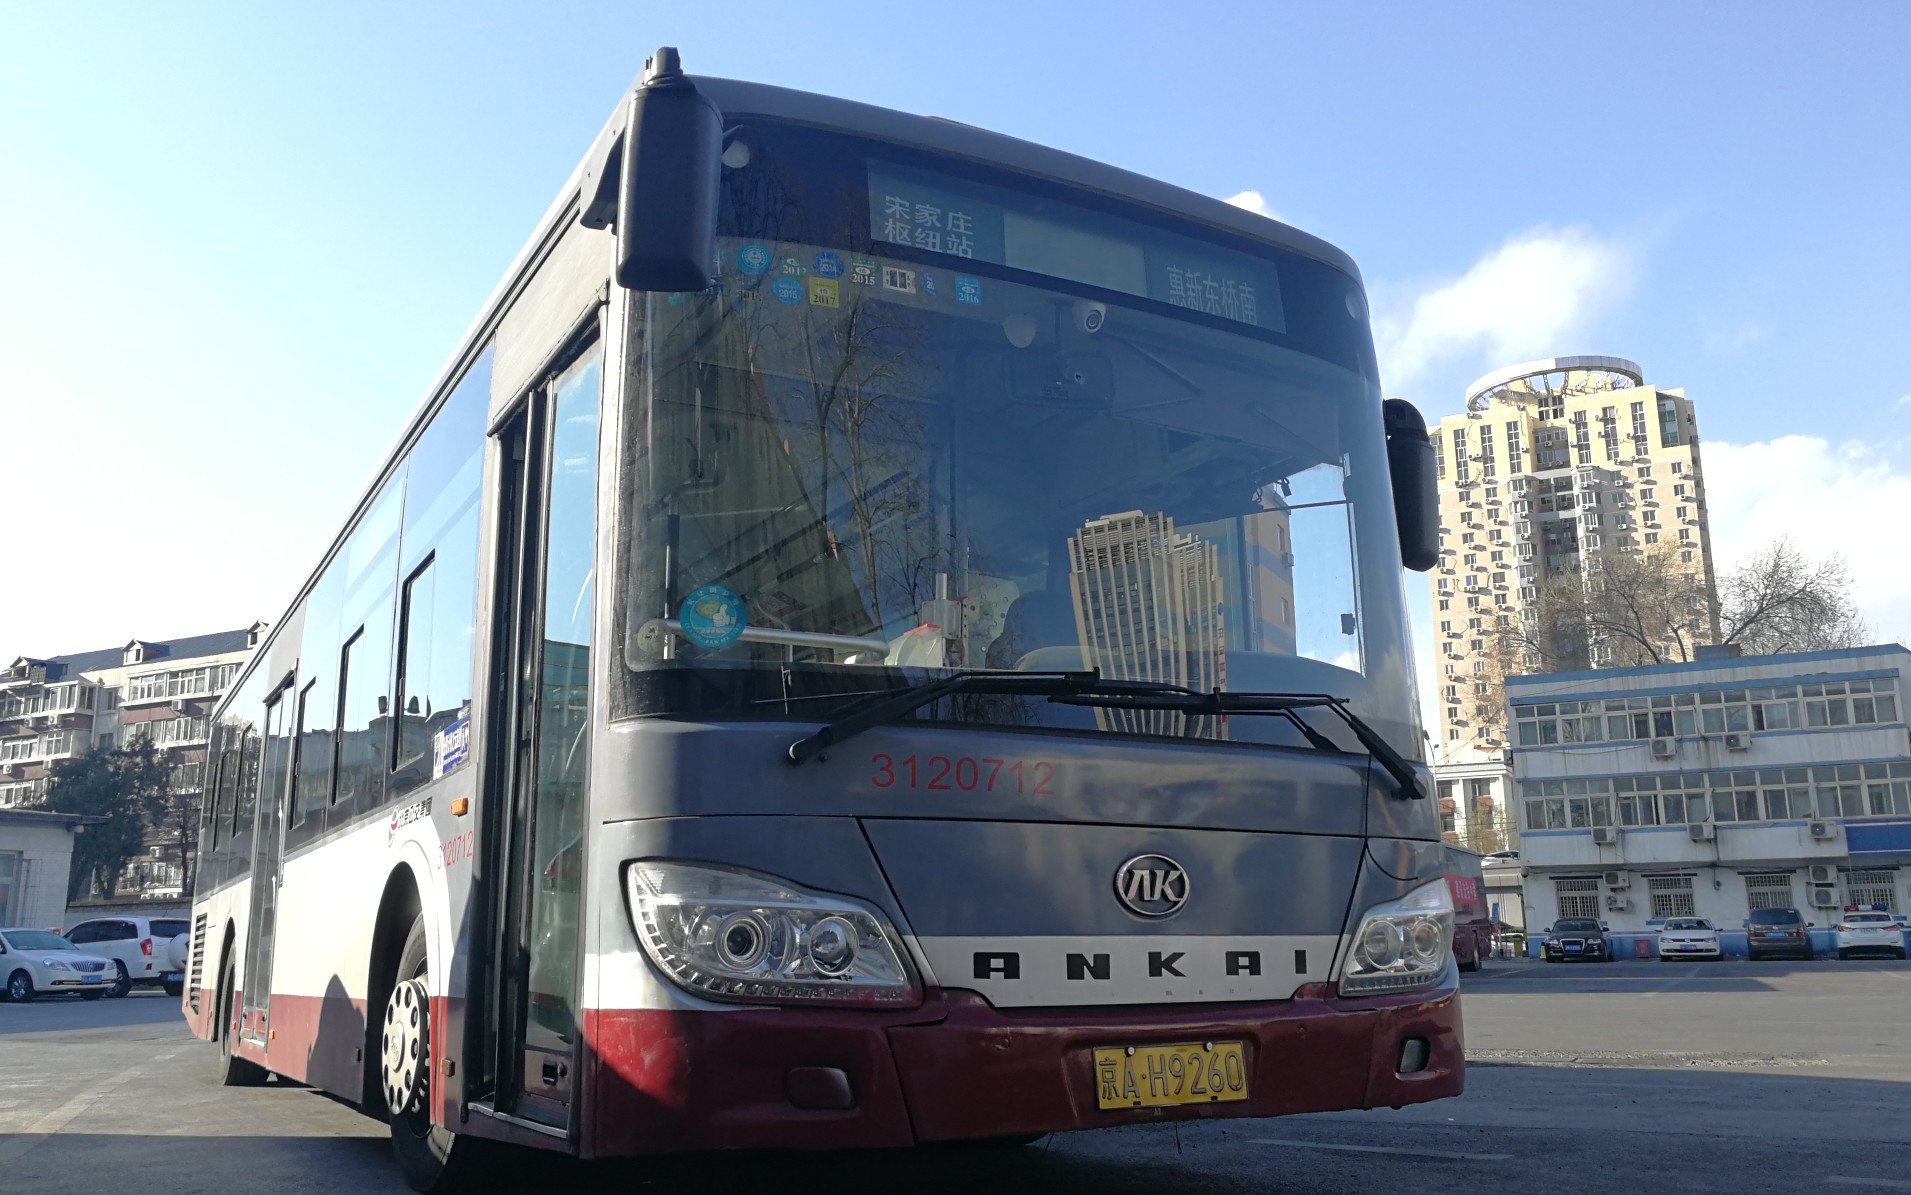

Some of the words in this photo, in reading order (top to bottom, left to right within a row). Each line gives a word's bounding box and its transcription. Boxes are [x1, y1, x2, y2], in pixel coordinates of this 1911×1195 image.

[885, 195, 974, 235] 宋家庄
[884, 218, 975, 259] 枢纽站
[852, 273, 876, 286] 2015
[1166, 264, 1258, 326] 惠新东桥南
[813, 294, 836, 306] 2017
[959, 292, 980, 304] 2016
[870, 753, 1056, 796] 3120712
[973, 950, 1307, 980] ANKAI
